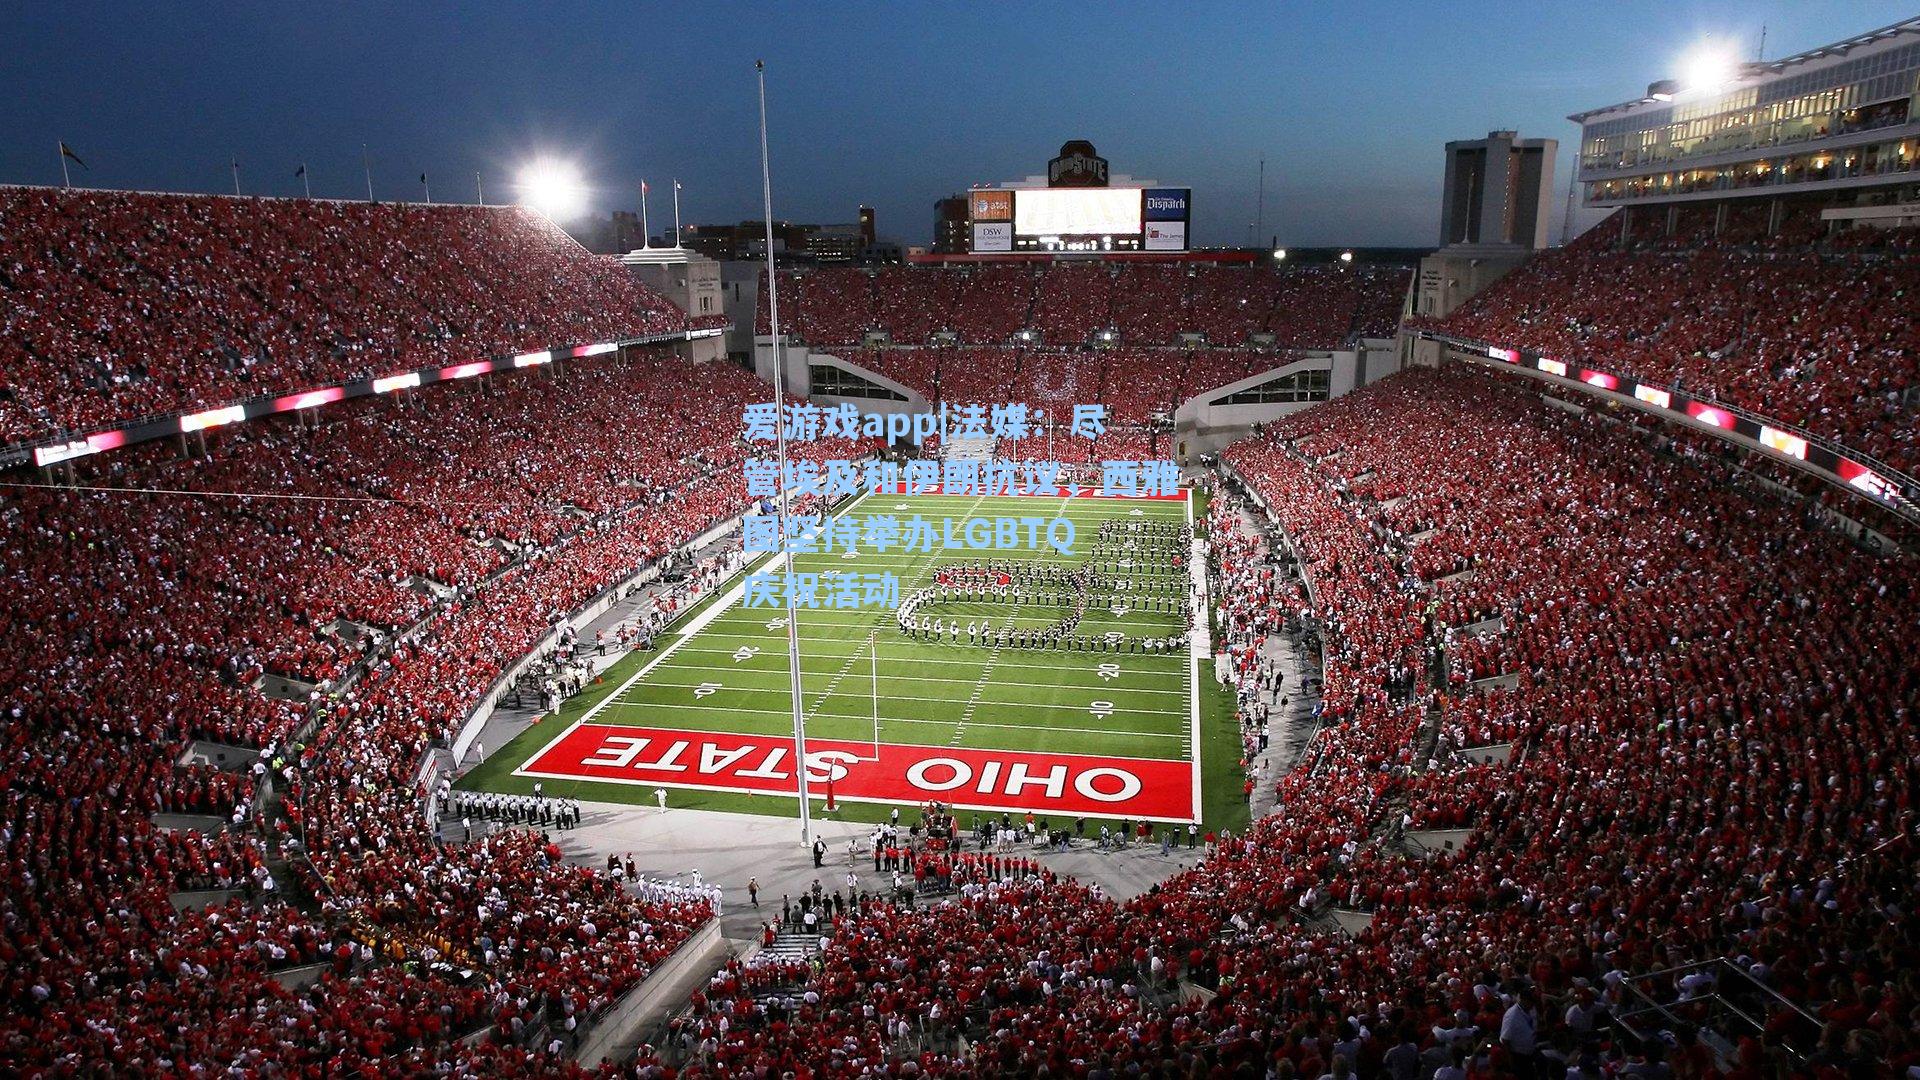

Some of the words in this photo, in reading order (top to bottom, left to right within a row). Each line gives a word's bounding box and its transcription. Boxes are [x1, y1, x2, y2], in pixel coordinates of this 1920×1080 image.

[1147, 197, 1185, 211] Dispatch
[983, 228, 1002, 236] DSW
[733, 646, 760, 659] 20
[1097, 664, 1120, 678] 20
[694, 682, 723, 695] 10
[1089, 701, 1114, 715] 10
[580, 736, 859, 783] STATE
[905, 757, 1143, 802] OHIO
